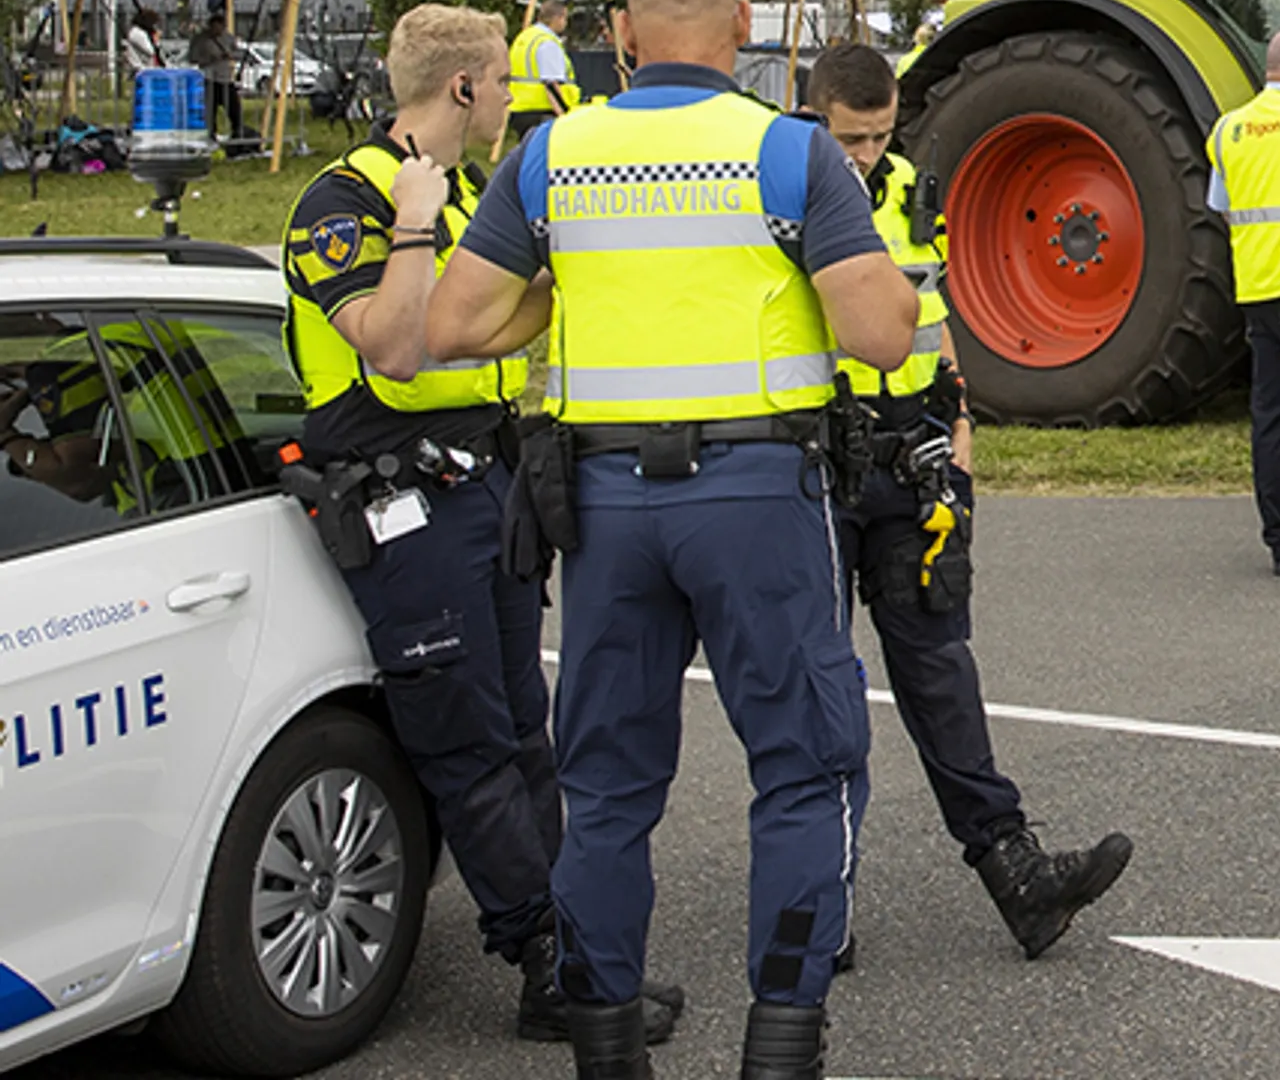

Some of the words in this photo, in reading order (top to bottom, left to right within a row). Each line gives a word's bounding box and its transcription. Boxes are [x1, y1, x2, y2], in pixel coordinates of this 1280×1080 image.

[554, 183, 741, 217] HANDHAVING
[16, 625, 43, 648] en
[43, 600, 136, 641] dienstbaar
[13, 673, 168, 768] LITIE
